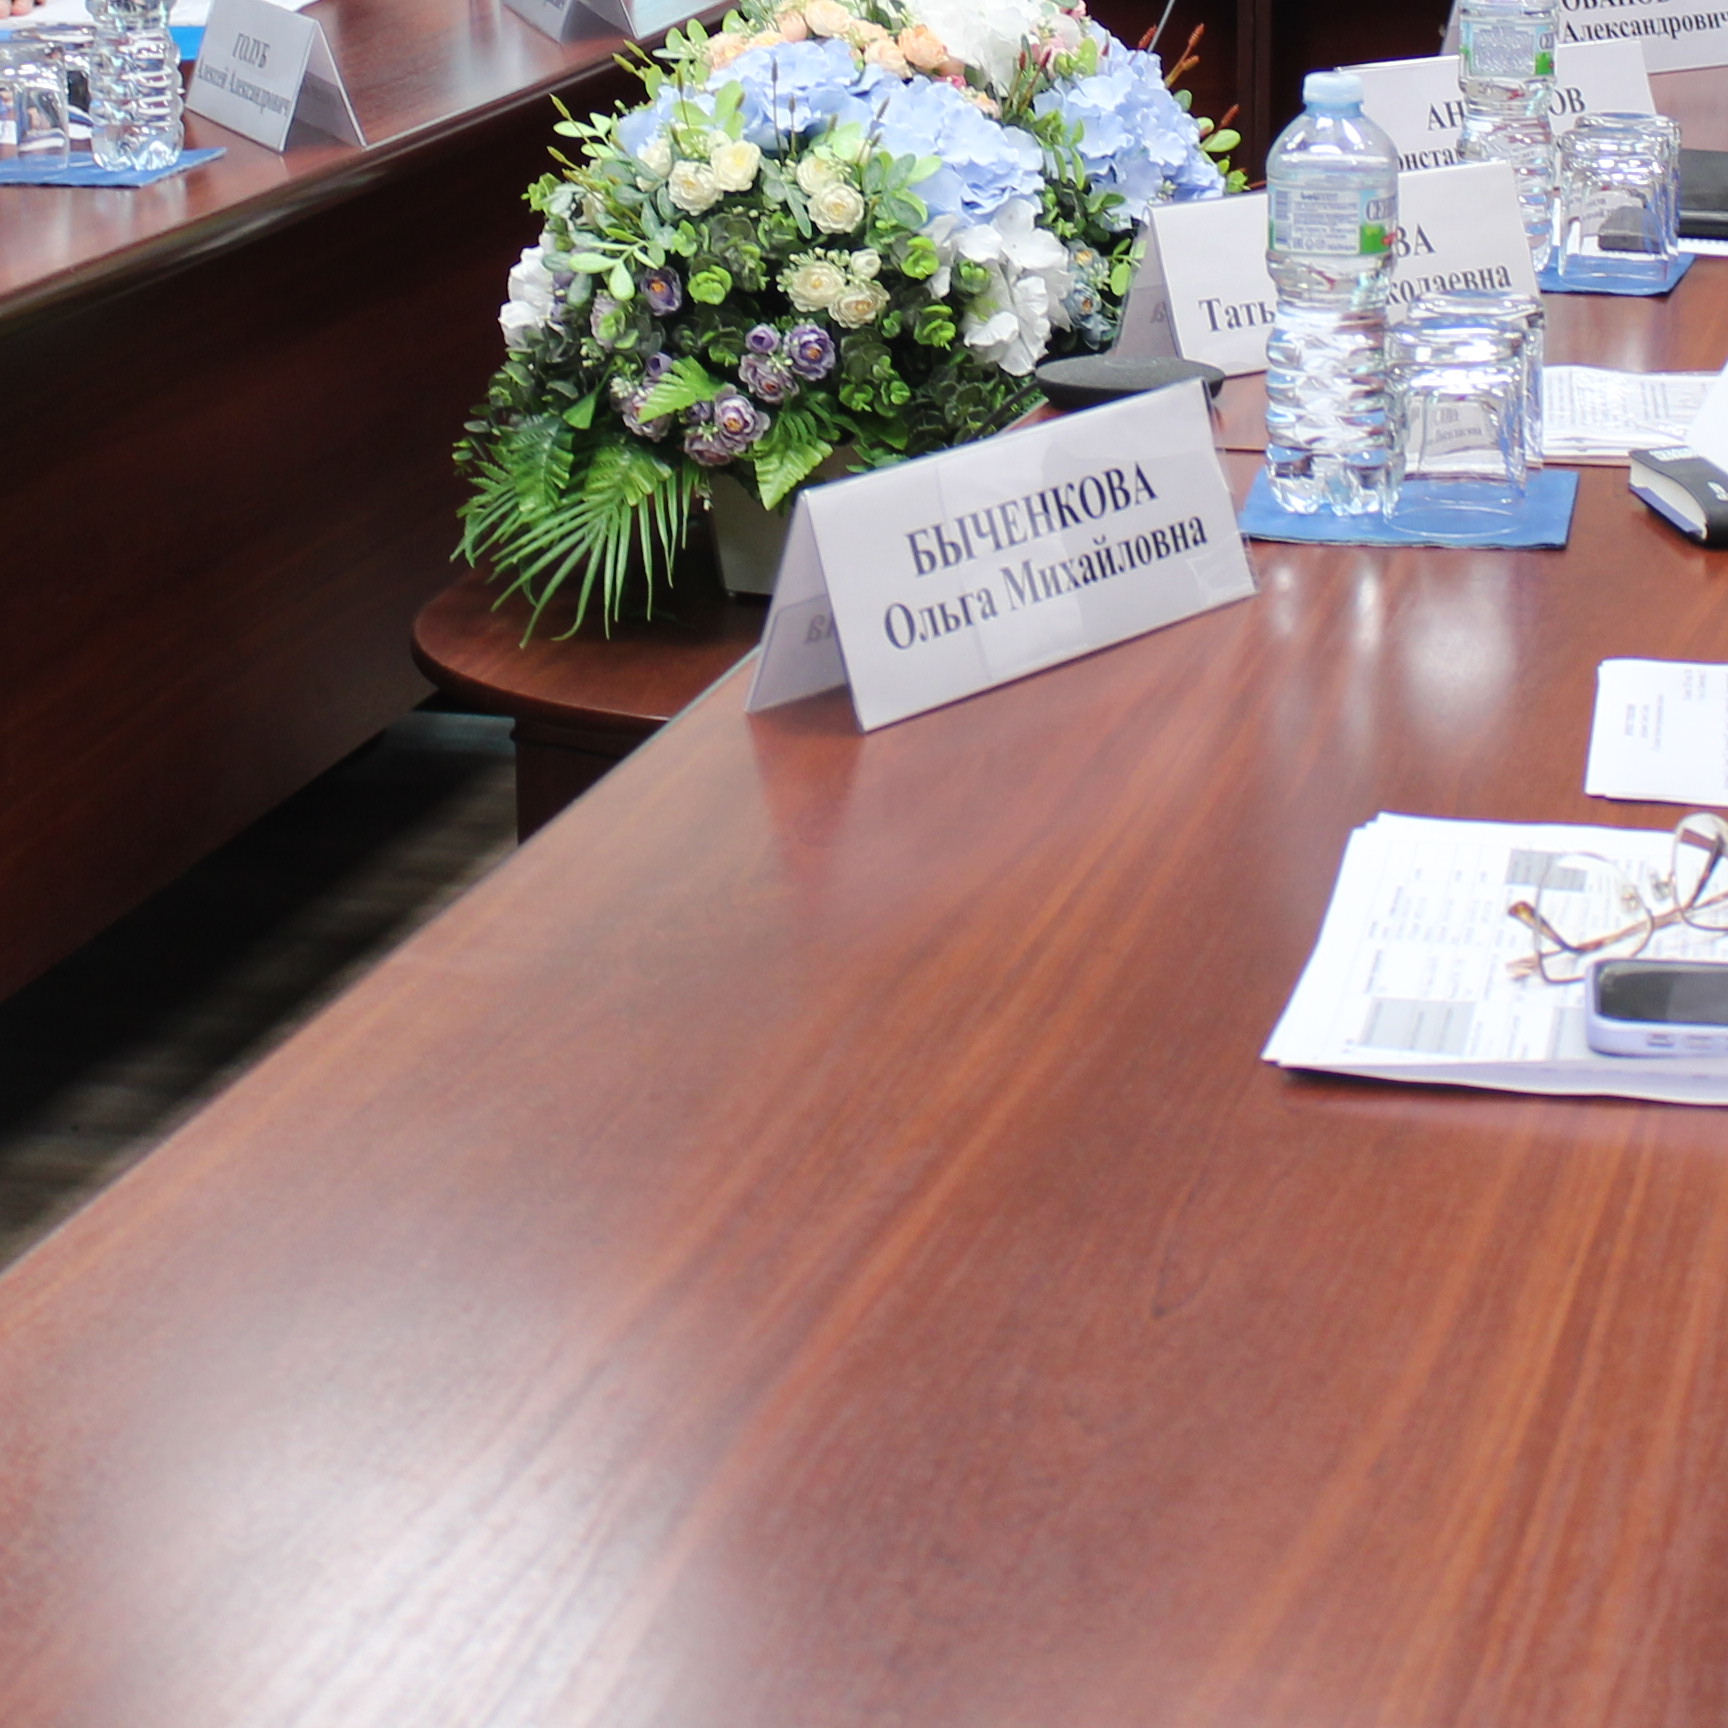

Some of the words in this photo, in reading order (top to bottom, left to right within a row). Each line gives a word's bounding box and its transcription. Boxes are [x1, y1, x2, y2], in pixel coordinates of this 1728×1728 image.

[1198, 297, 1276, 333] Тать
[1386, 264, 1513, 306] колаевна
[905, 461, 1159, 577] БЫЧЕНКОВА
[883, 587, 1000, 651] Ольга
[1000, 515, 1208, 612] Михайловна
